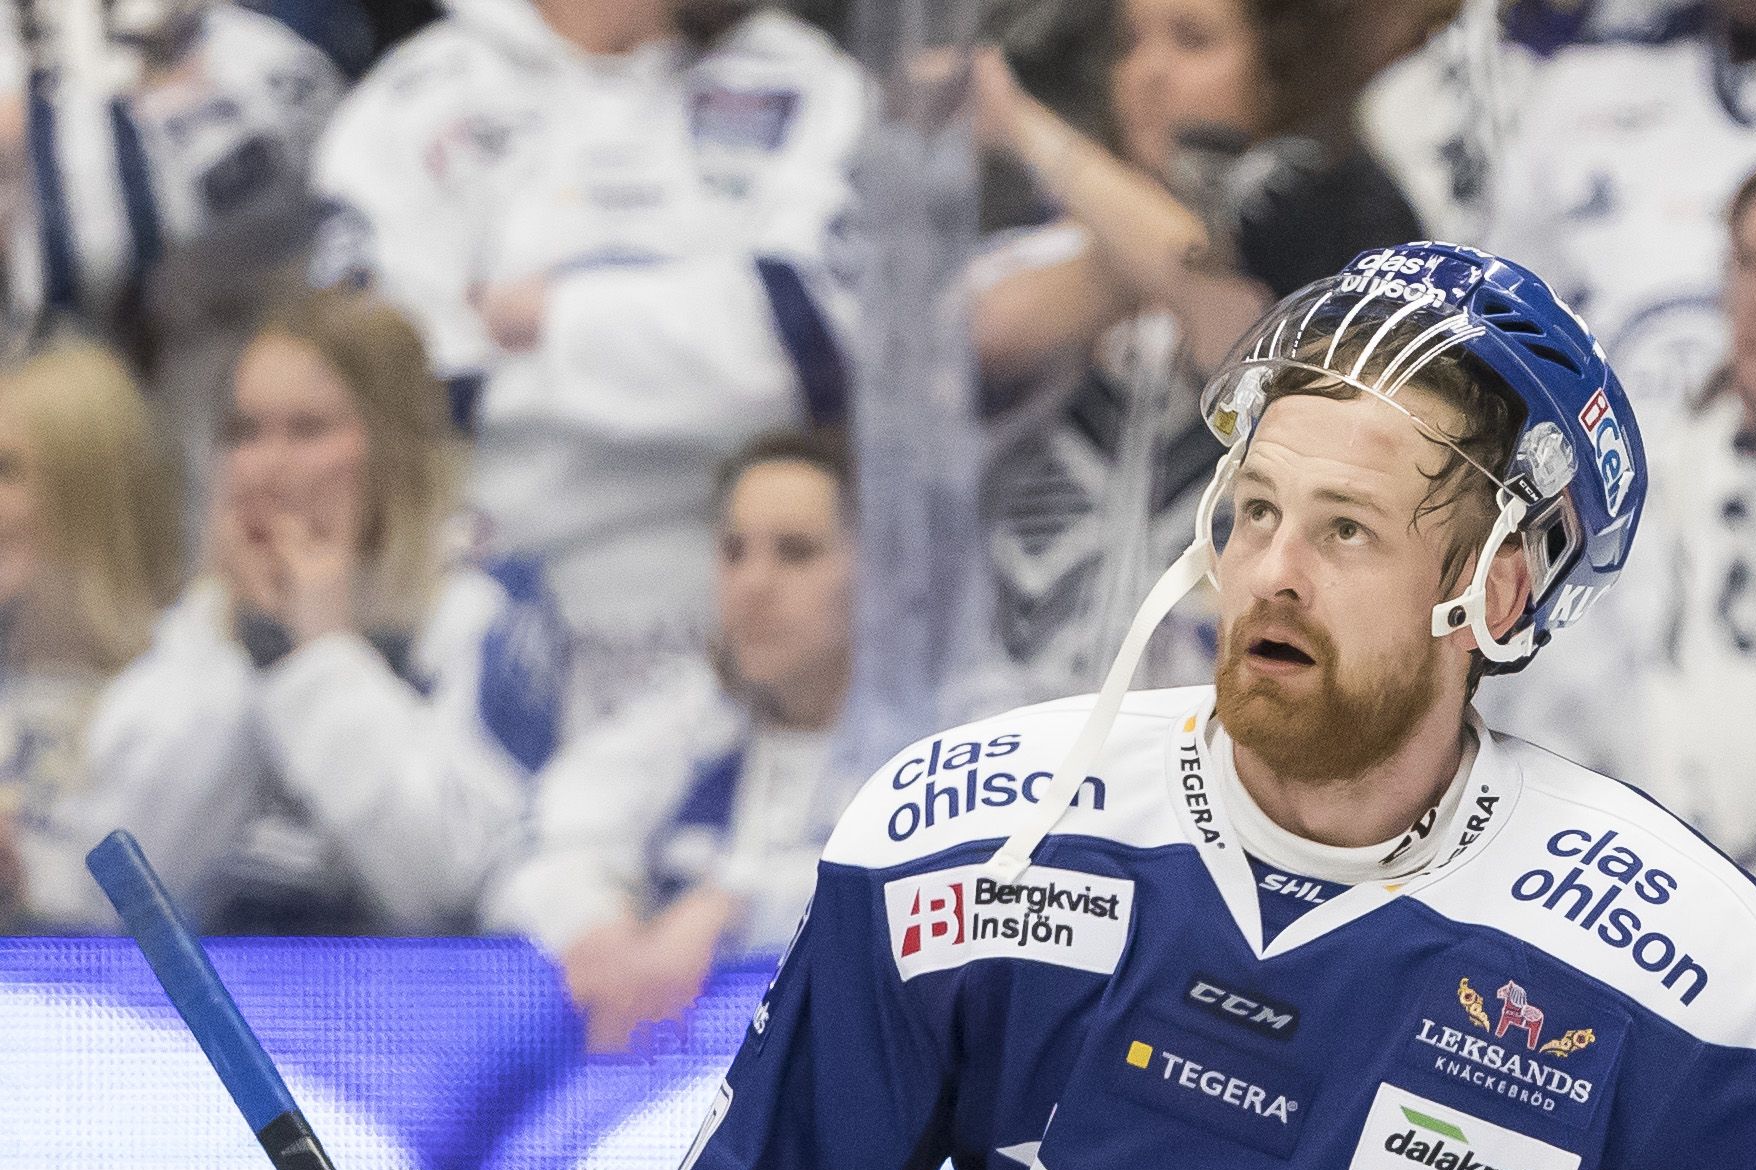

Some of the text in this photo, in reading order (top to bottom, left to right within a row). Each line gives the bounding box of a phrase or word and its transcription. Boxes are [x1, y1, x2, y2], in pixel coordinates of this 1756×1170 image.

[892, 733, 1022, 791] clas
[1258, 872, 1327, 904] SHL
[1545, 828, 1678, 906] clas
[974, 877, 1120, 921] Bergkvist
[972, 911, 1074, 947] Insjön
[1510, 869, 1709, 1007] ohlson
[1190, 980, 1295, 1032] CCM
[1415, 1018, 1593, 1104] LEKSANDS
[1433, 1055, 1556, 1112] KNÄCKEBRÖD
